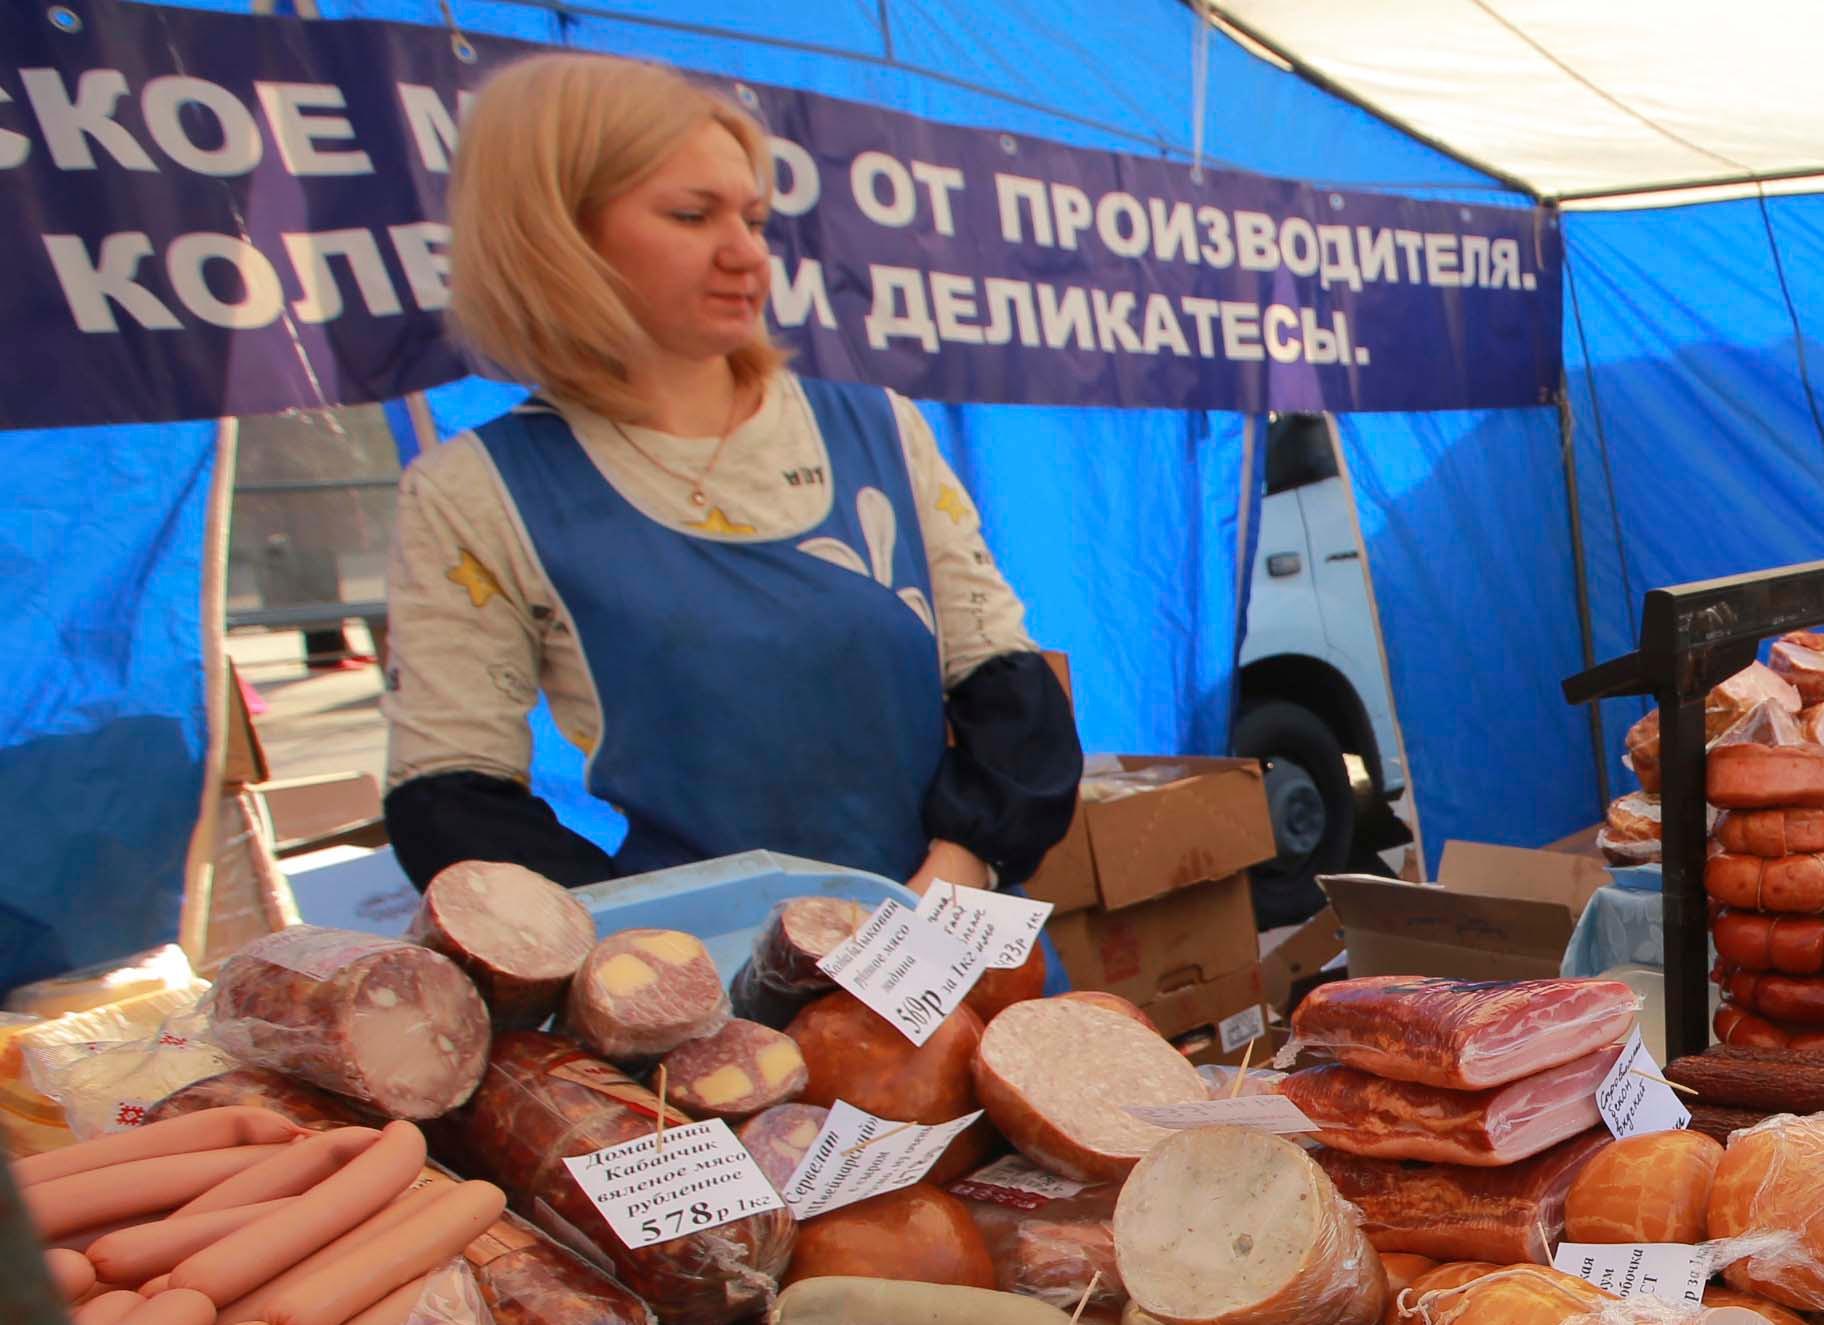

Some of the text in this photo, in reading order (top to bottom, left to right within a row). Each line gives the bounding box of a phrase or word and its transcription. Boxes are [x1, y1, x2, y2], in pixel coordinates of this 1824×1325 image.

[851, 149, 964, 237] ОТ
[995, 172, 1537, 291] ПРОИЗВОДИТЕЛЯ.
[867, 265, 1370, 367] ДЕЛИКАТЕСЫ.
[885, 923, 911, 956] мясо
[951, 951, 977, 978] 1кг
[1608, 1079, 1632, 1118] бекон
[597, 1151, 747, 1203] вяленое мясо
[605, 1140, 720, 1181] Кабанчик
[786, 1130, 839, 1205] Сервелат
[626, 1169, 744, 1218] рубленное
[641, 1194, 772, 1242] 578р 1кг
[1600, 1268, 1615, 1291] ум
